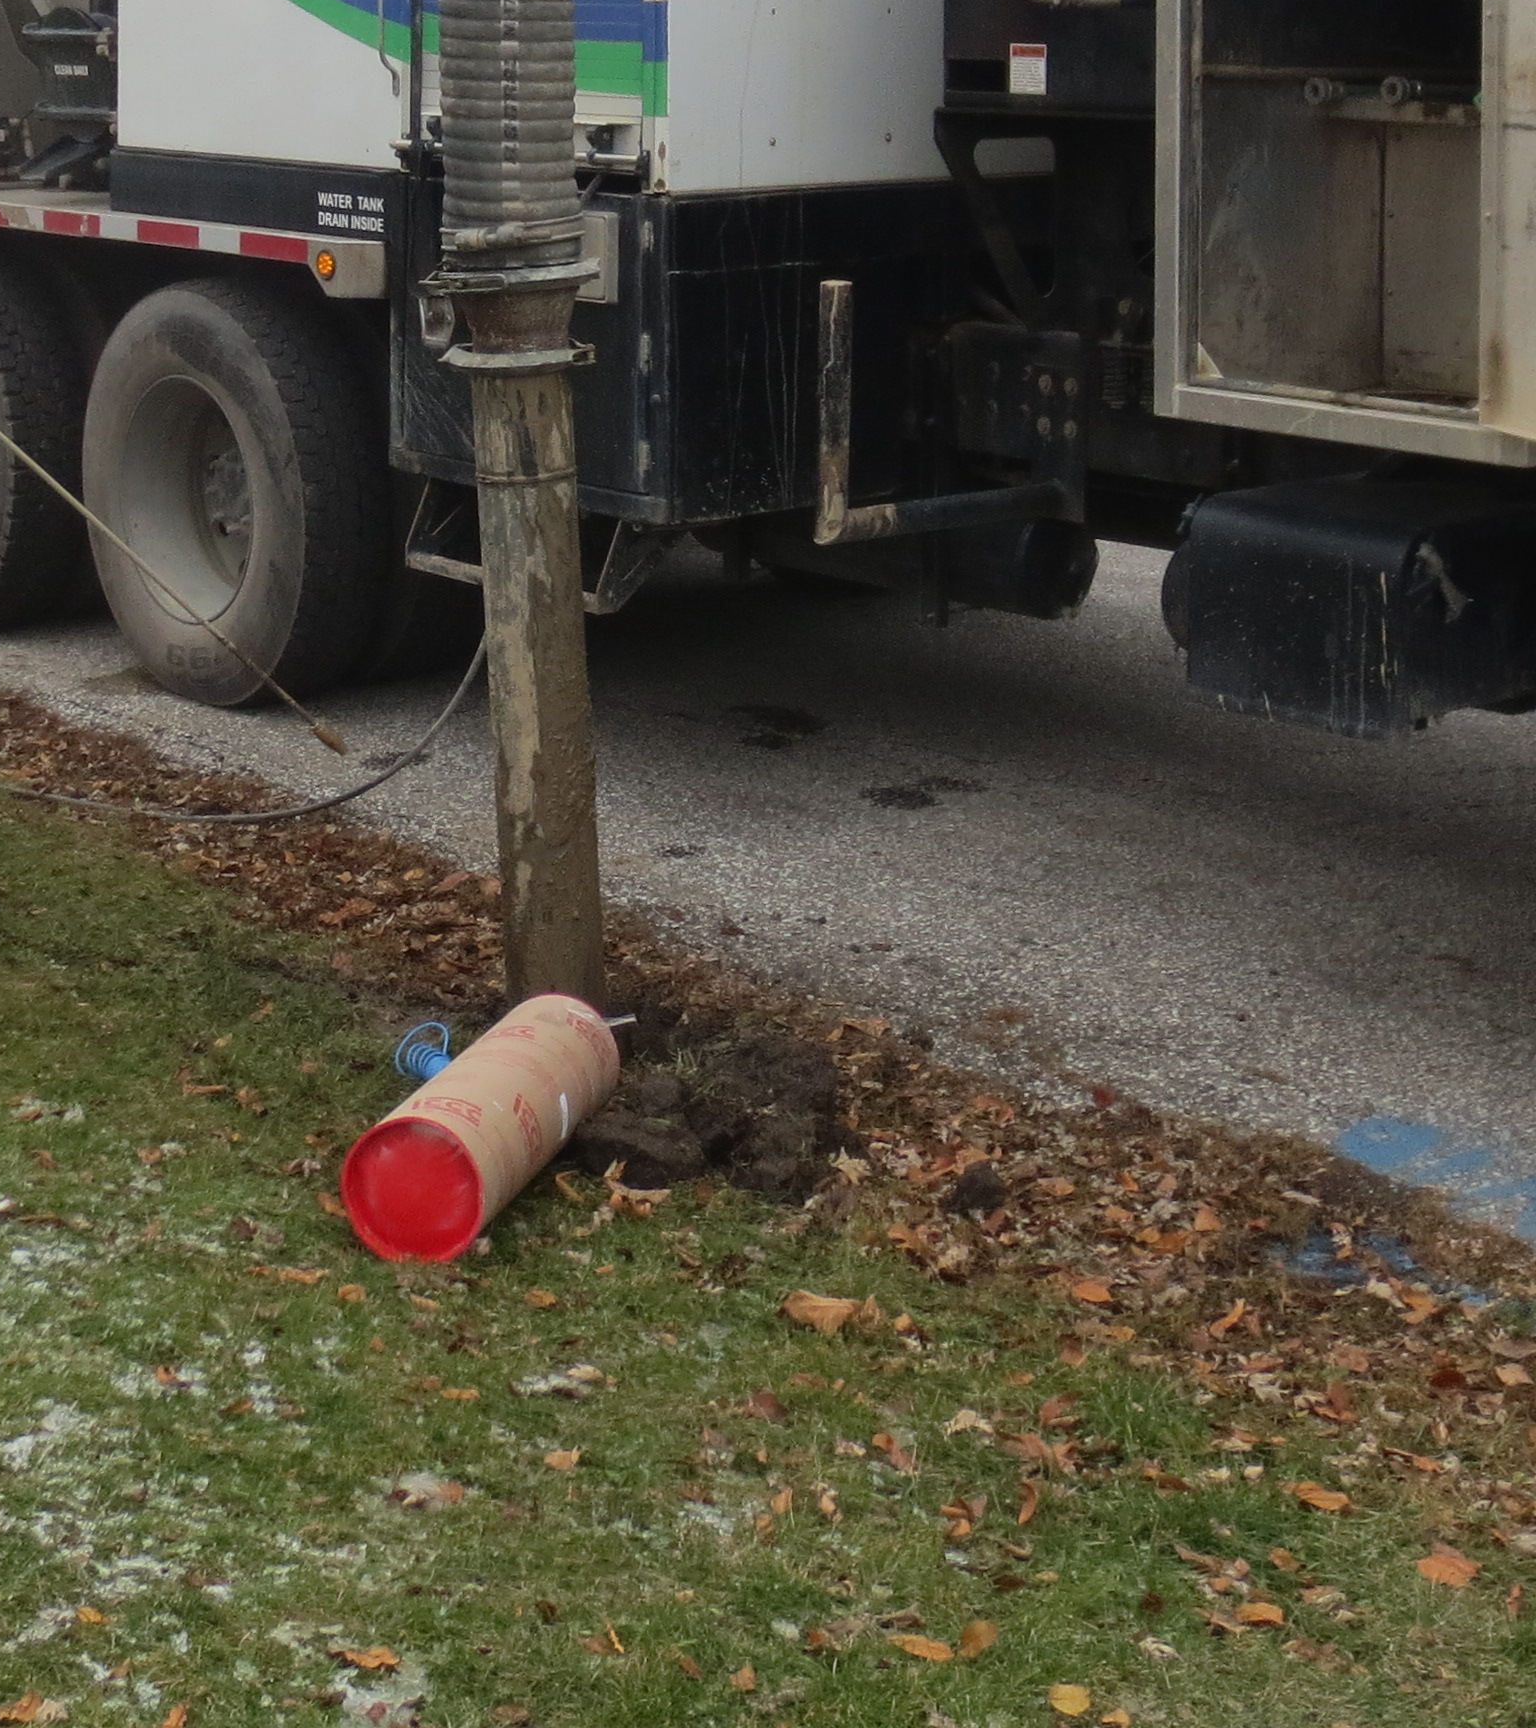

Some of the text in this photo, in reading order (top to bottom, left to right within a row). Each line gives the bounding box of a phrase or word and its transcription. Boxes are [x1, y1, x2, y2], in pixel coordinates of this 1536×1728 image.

[317, 192, 384, 213] WATER TANK
[317, 212, 385, 233] DRAIN INSIDE
